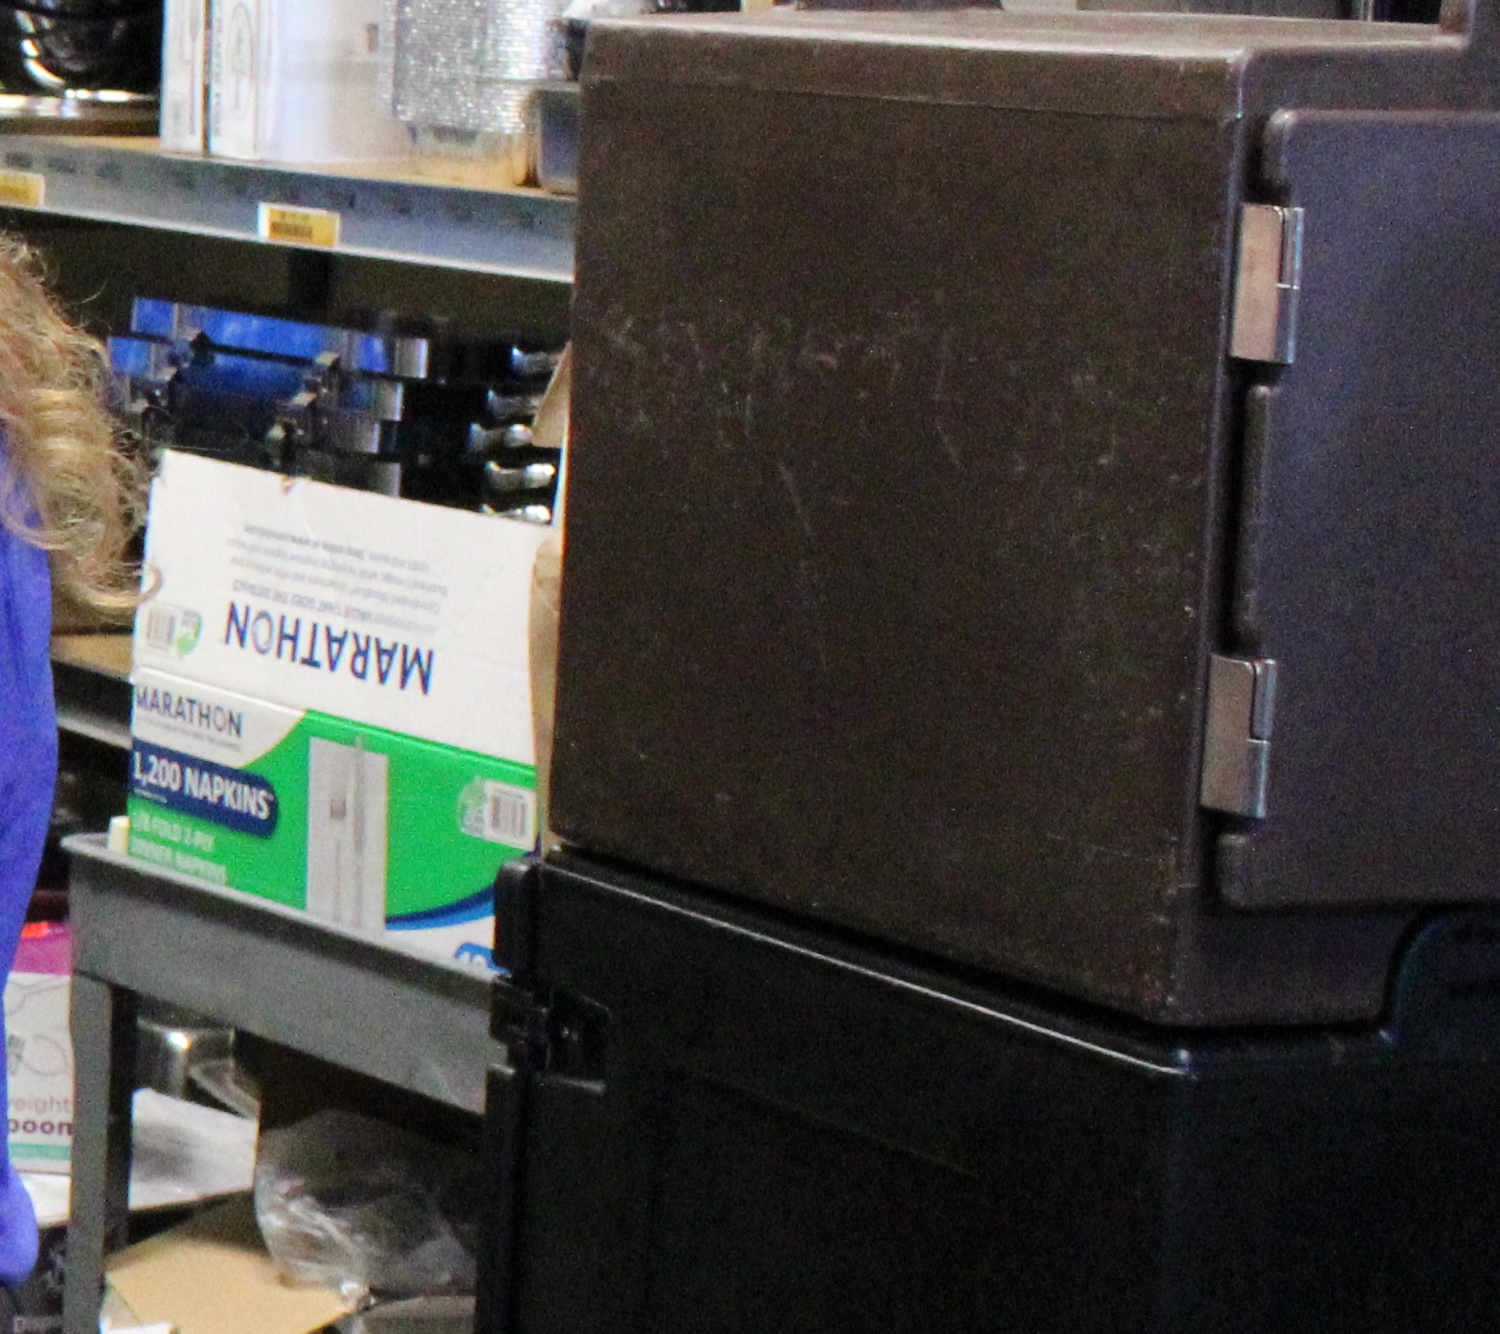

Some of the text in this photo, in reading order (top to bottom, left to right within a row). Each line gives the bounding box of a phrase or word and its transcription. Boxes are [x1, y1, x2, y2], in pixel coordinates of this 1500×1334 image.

[224, 601, 436, 696] MARATHON
[136, 685, 244, 739] MARATHON
[133, 751, 271, 821] 1,200 NAPKINS
